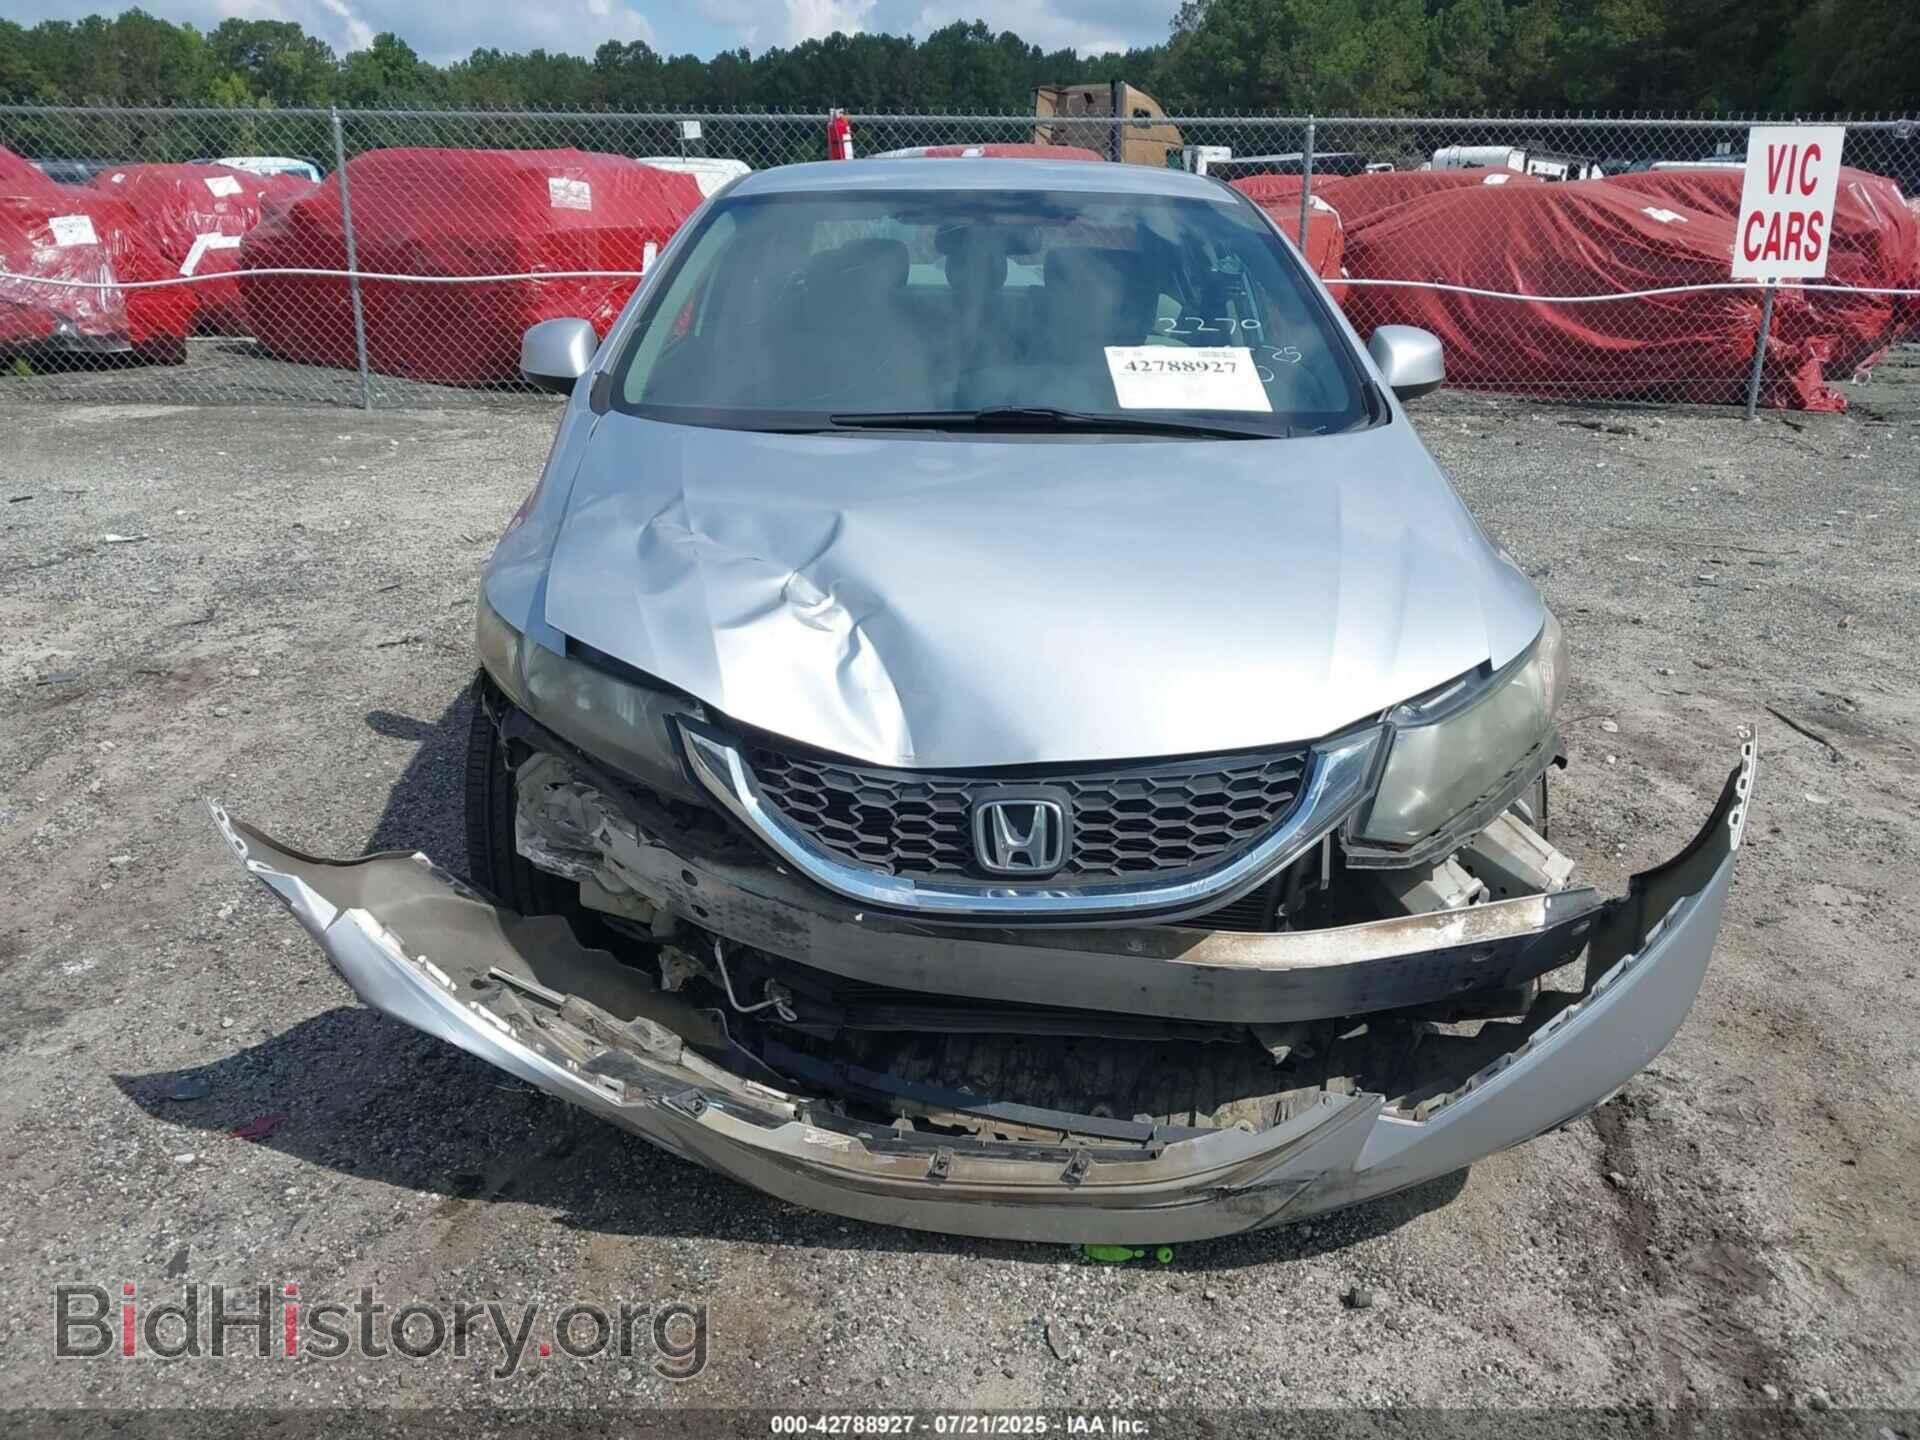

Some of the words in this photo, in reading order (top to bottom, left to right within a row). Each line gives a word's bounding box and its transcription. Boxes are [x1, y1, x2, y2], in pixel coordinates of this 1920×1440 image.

[1768, 143, 1822, 195] VIC
[1742, 210, 1825, 262] CARS
[1158, 316, 1261, 335] 2270
[1124, 359, 1237, 373] 42788927
